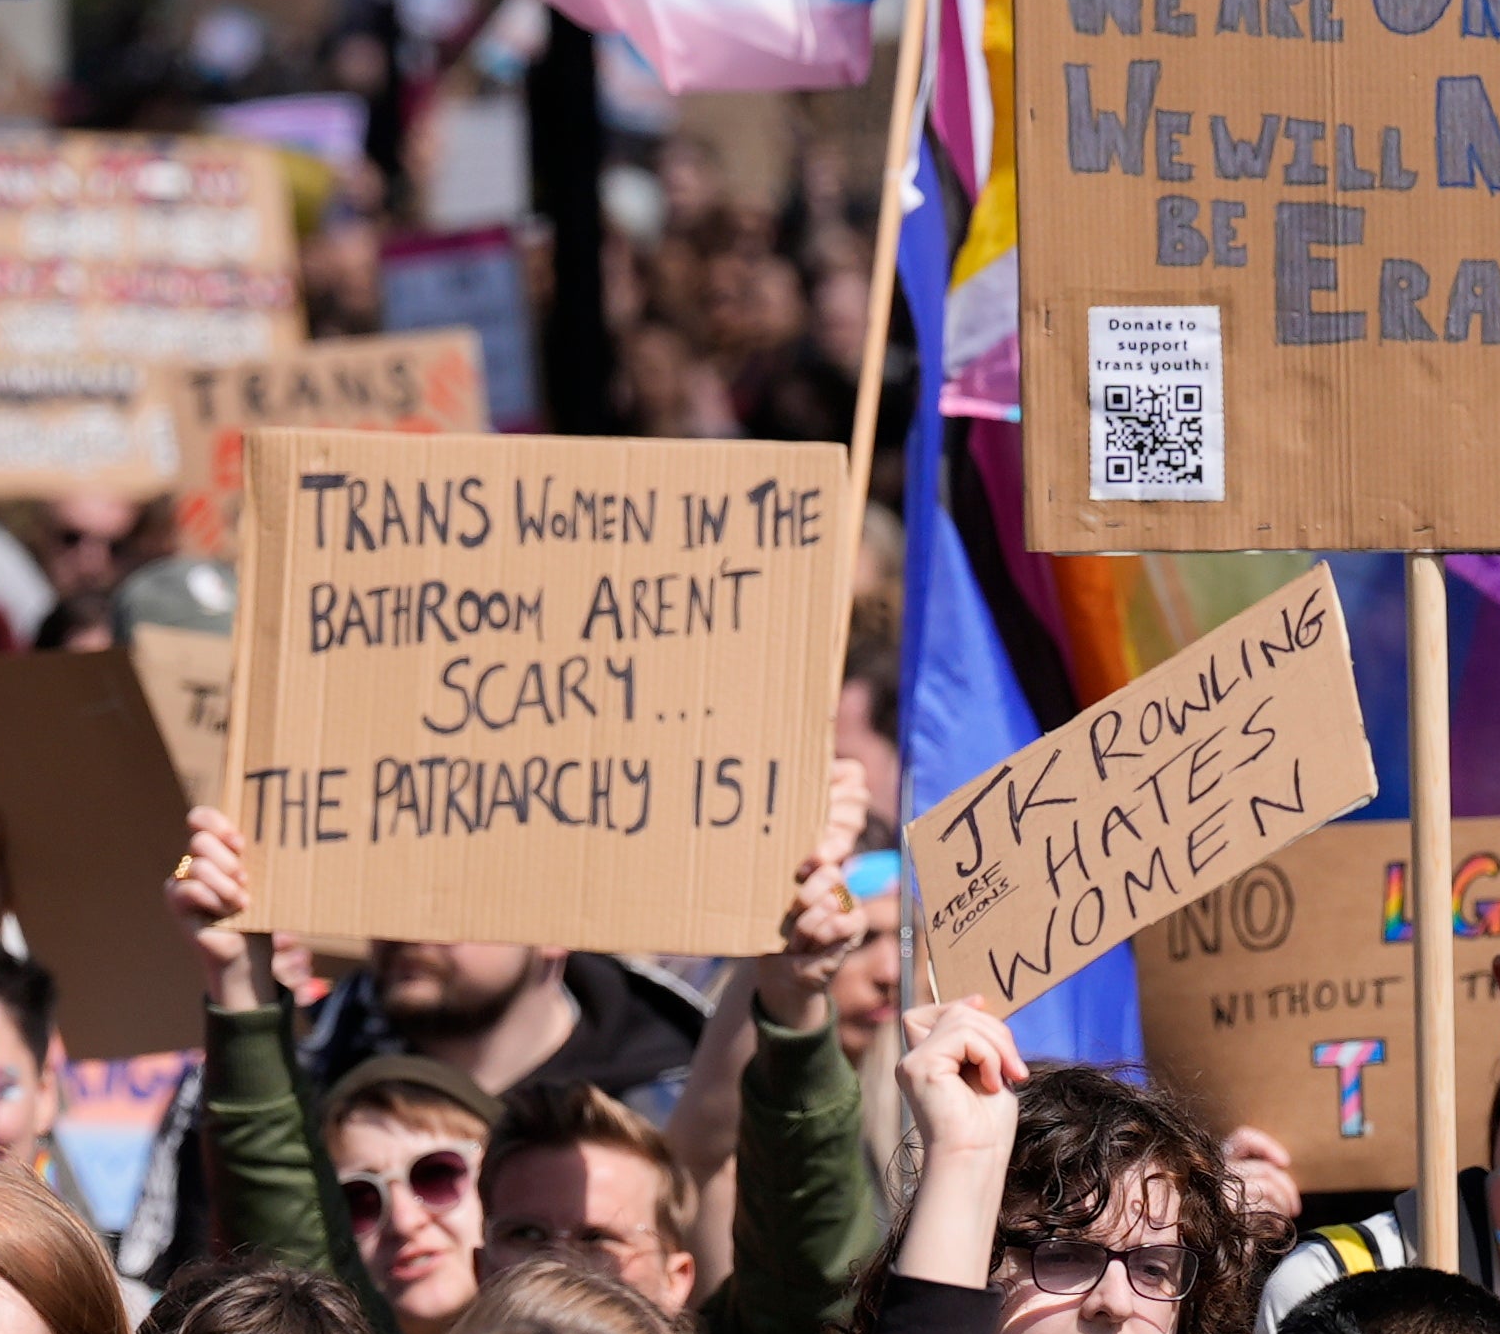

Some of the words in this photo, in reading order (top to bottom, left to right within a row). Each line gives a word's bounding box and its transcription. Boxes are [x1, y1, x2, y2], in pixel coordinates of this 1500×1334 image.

[1064, 61, 1193, 182] WE
[1209, 113, 1418, 193] WILL
[1156, 194, 1248, 267] BE
[1097, 360, 1143, 371] trans
[1150, 359, 1210, 374] youth:
[1109, 319, 1173, 331] Donate
[1180, 320, 1196, 331] to
[1118, 340, 1188, 355] support
[300, 473, 491, 552] TRANS
[515, 475, 657, 545] WOMEN
[680, 493, 730, 552] IN
[746, 478, 824, 549] THE
[309, 579, 545, 655] BATHROOM
[421, 654, 714, 737] SCARY...
[937, 748, 1077, 880] JK
[1089, 588, 1329, 780] ROWLING
[243, 766, 349, 850] THE
[370, 755, 651, 845] PATRIARCHY
[1043, 695, 1277, 899] HATES
[988, 757, 1307, 1003] WOMEN
[1166, 862, 1295, 961] NO
[1210, 974, 1403, 1031] WITHOUT
[1311, 1038, 1389, 1139] T
